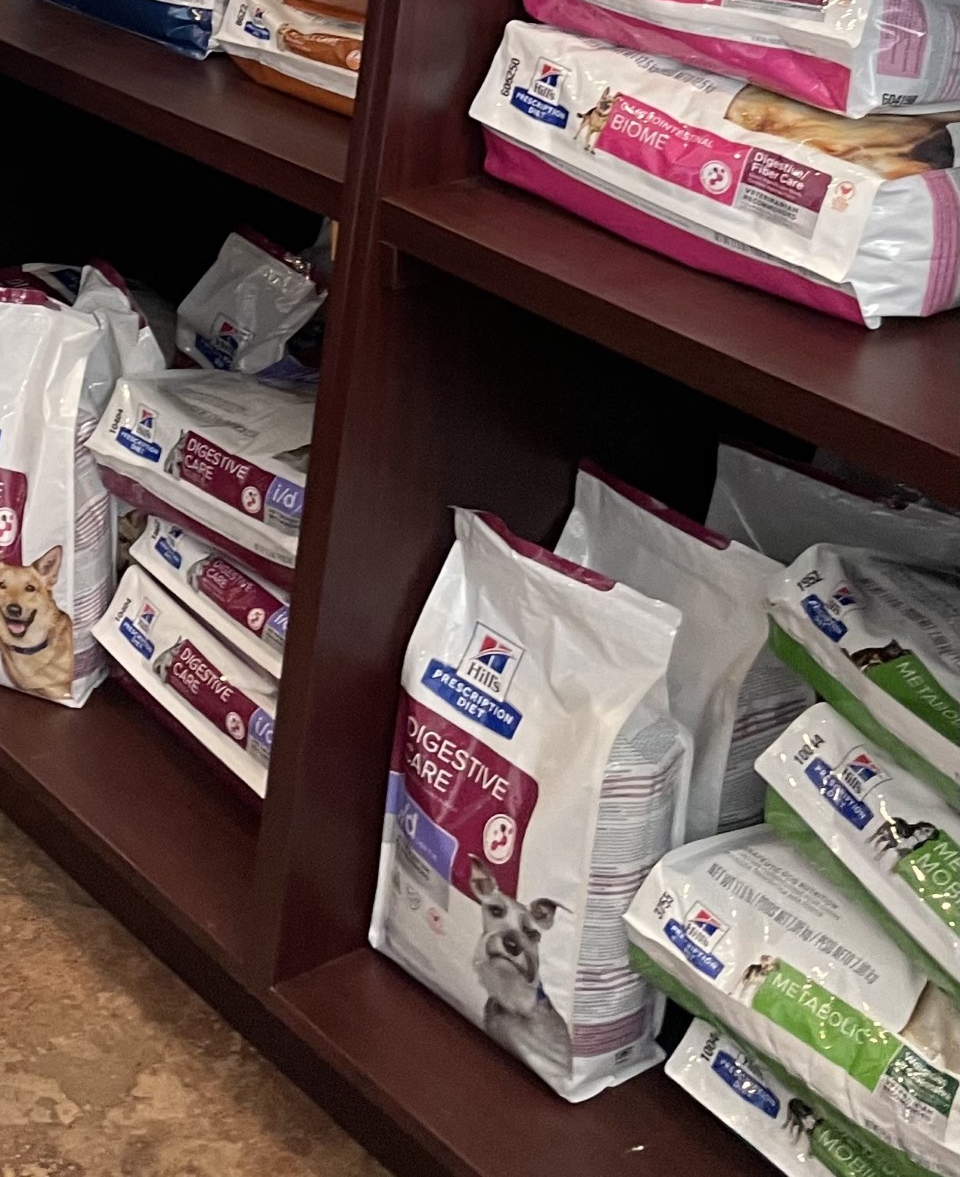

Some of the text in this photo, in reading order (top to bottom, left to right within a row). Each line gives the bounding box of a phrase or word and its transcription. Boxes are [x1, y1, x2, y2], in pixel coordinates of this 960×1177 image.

[500, 58, 521, 97] 605250
[515, 92, 567, 121] PRESCRIPTION
[610, 113, 670, 151] BIOME
[751, 162, 805, 191] Fiber Care
[745, 187, 800, 214] VETERINARIAN
[184, 454, 214, 481] CARE
[186, 438, 250, 480] DIGESTIVE
[271, 483, 297, 509] i/d
[172, 662, 201, 695] CARE
[180, 646, 235, 703] DIGESTIVE
[467, 661, 502, 694] Hill's
[432, 669, 515, 726] PRESCRIPTION
[456, 696, 487, 719] DIET
[408, 715, 510, 802] DIGESTIVE
[771, 972, 868, 1045] METABOLIC
